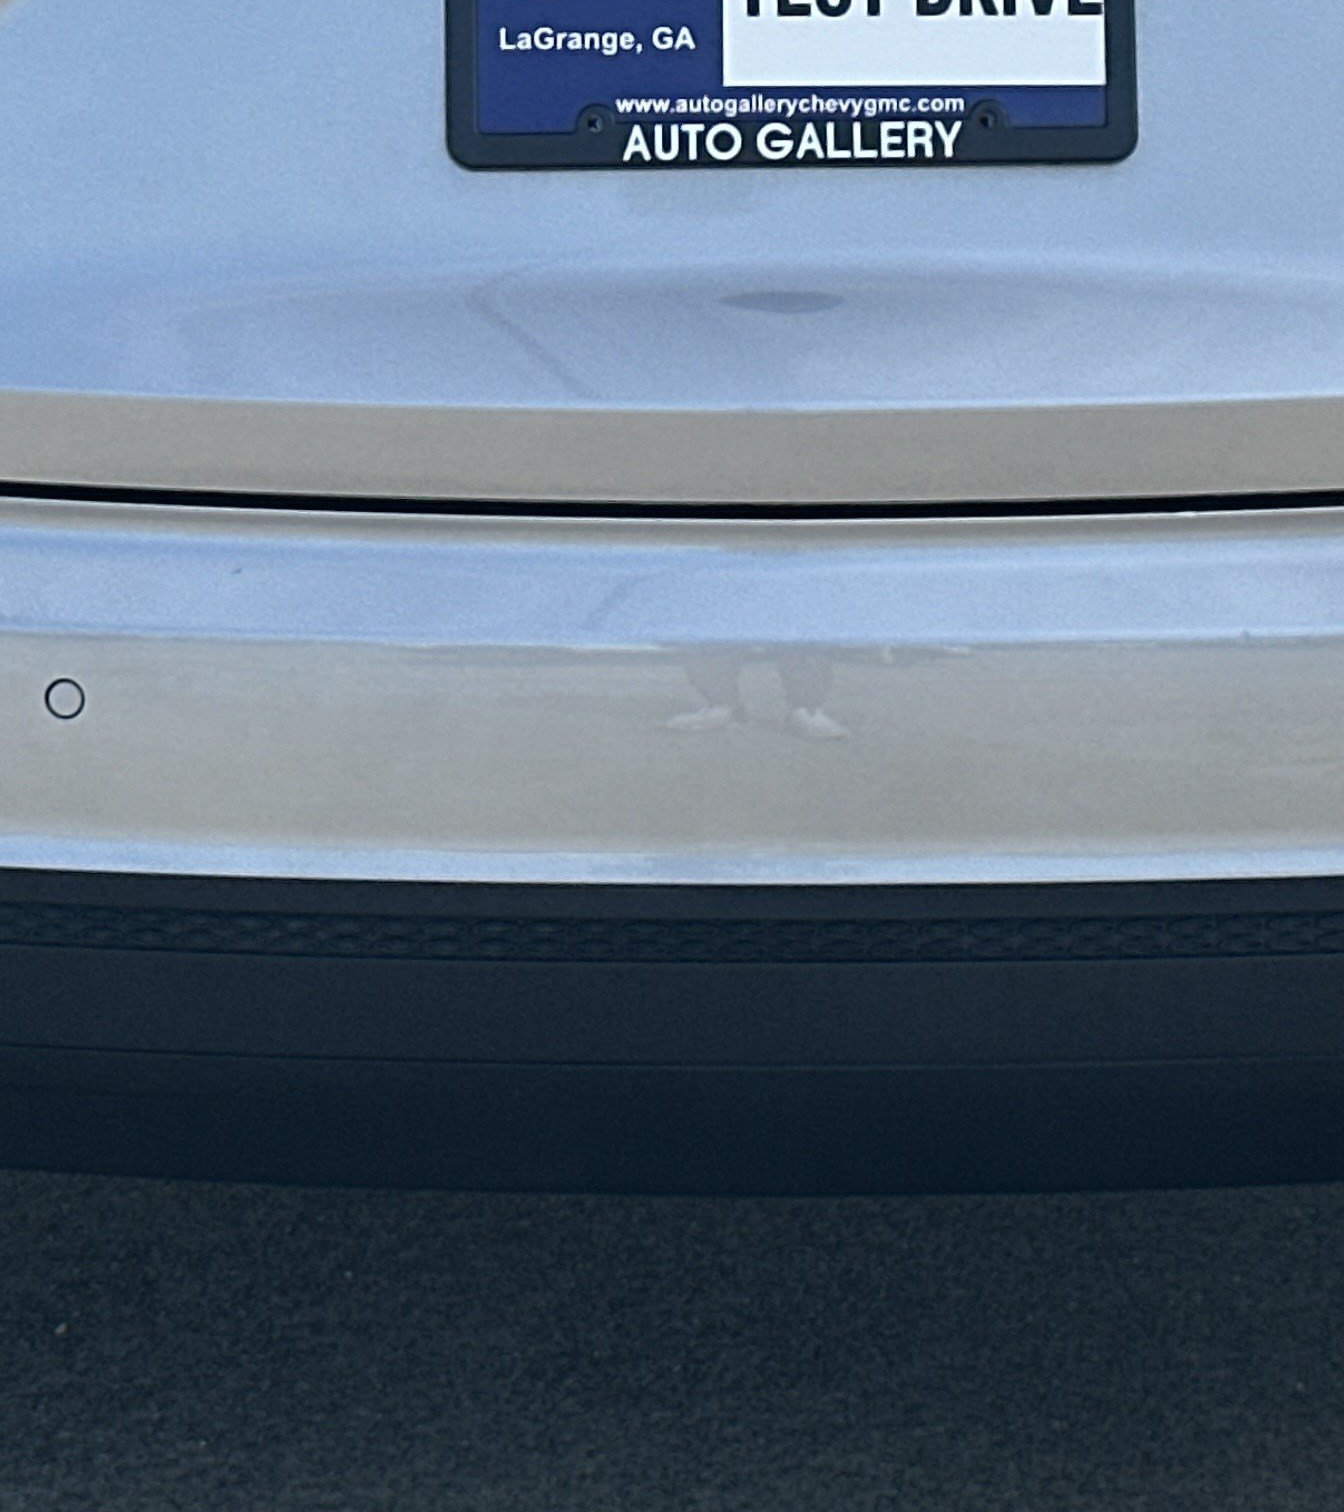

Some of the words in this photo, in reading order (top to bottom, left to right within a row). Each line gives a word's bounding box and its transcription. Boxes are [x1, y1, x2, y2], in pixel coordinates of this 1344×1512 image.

[498, 26, 643, 55] LaGrange,
[652, 26, 696, 51] GA
[614, 93, 966, 118] www.autogallerychevygmc.com
[622, 122, 743, 162] AUTO
[755, 119, 963, 161] GALLERY
